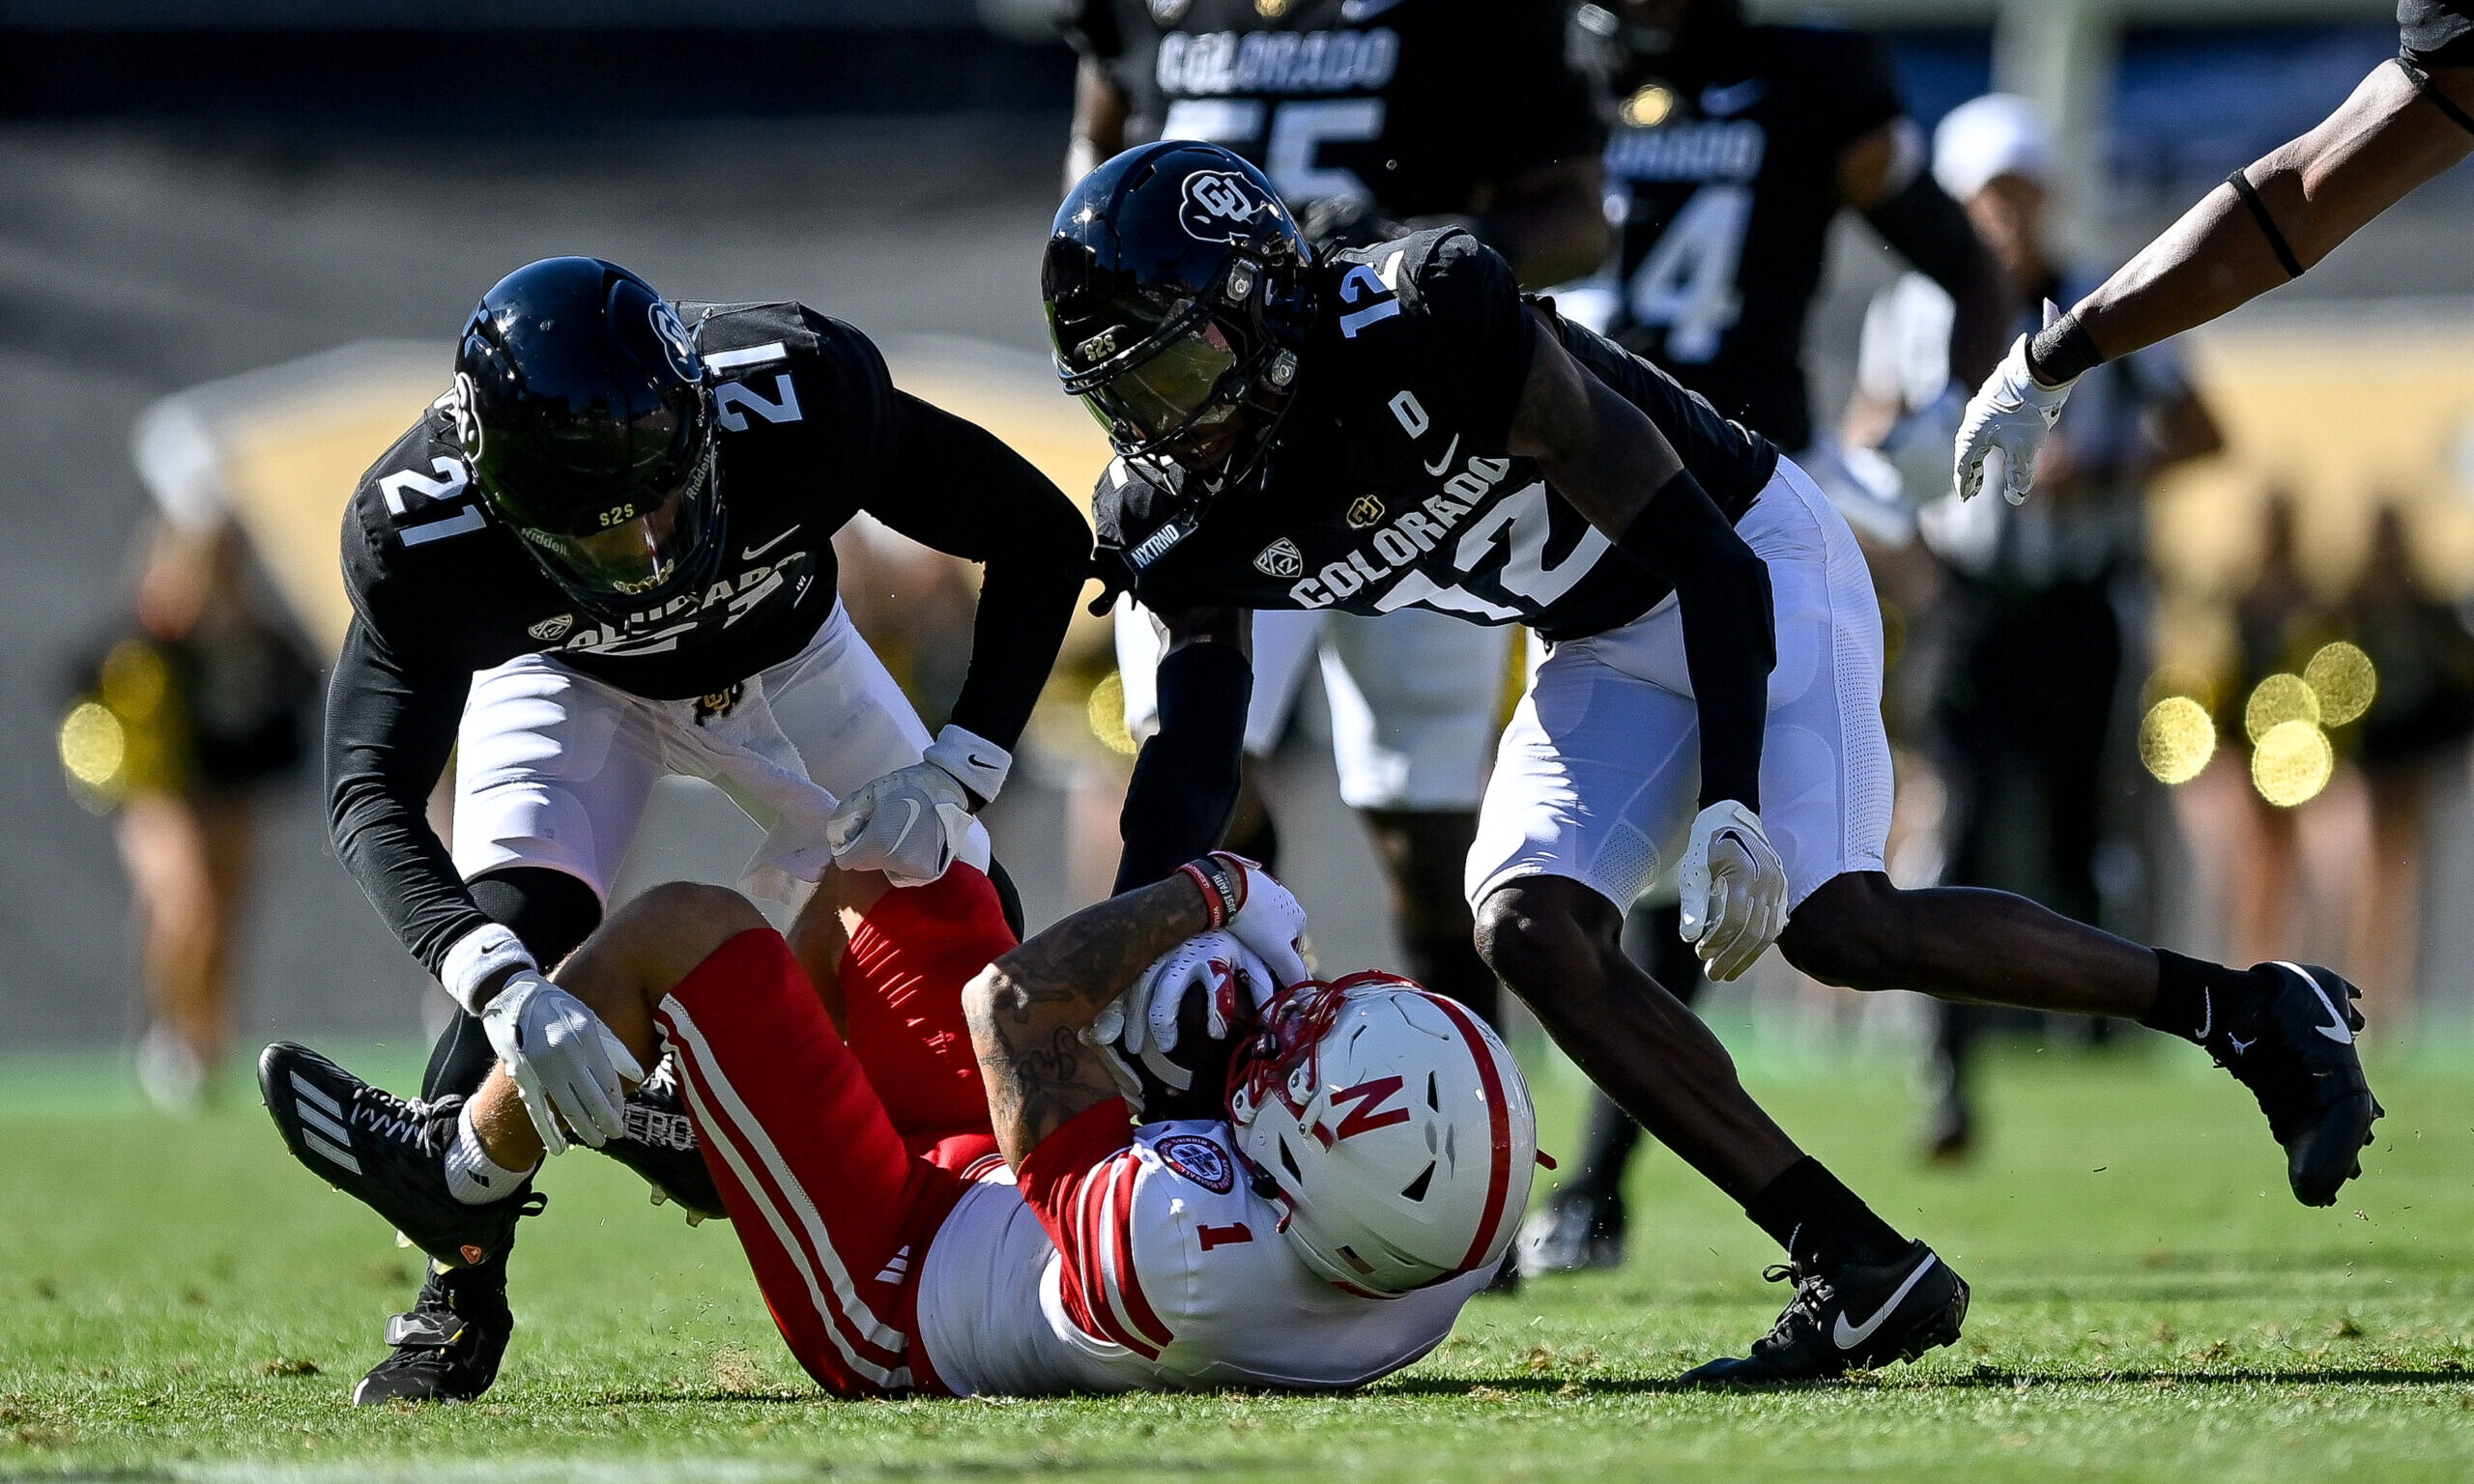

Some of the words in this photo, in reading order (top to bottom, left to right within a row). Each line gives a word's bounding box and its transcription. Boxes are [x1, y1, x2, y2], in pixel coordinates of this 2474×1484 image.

[703, 341, 803, 432] 21
[686, 453, 711, 500] Riddell
[378, 456, 486, 549] 21
[521, 528, 568, 556] Riddell
[1131, 524, 1181, 569] NXTRND
[1289, 456, 1510, 609] COLORADO
[1373, 480, 1611, 621] 12
[1212, 873, 1229, 895] FAITH
[1223, 895, 1237, 914] JUST
[1329, 1075, 1410, 1142] N
[1196, 1220, 1253, 1252] 1
